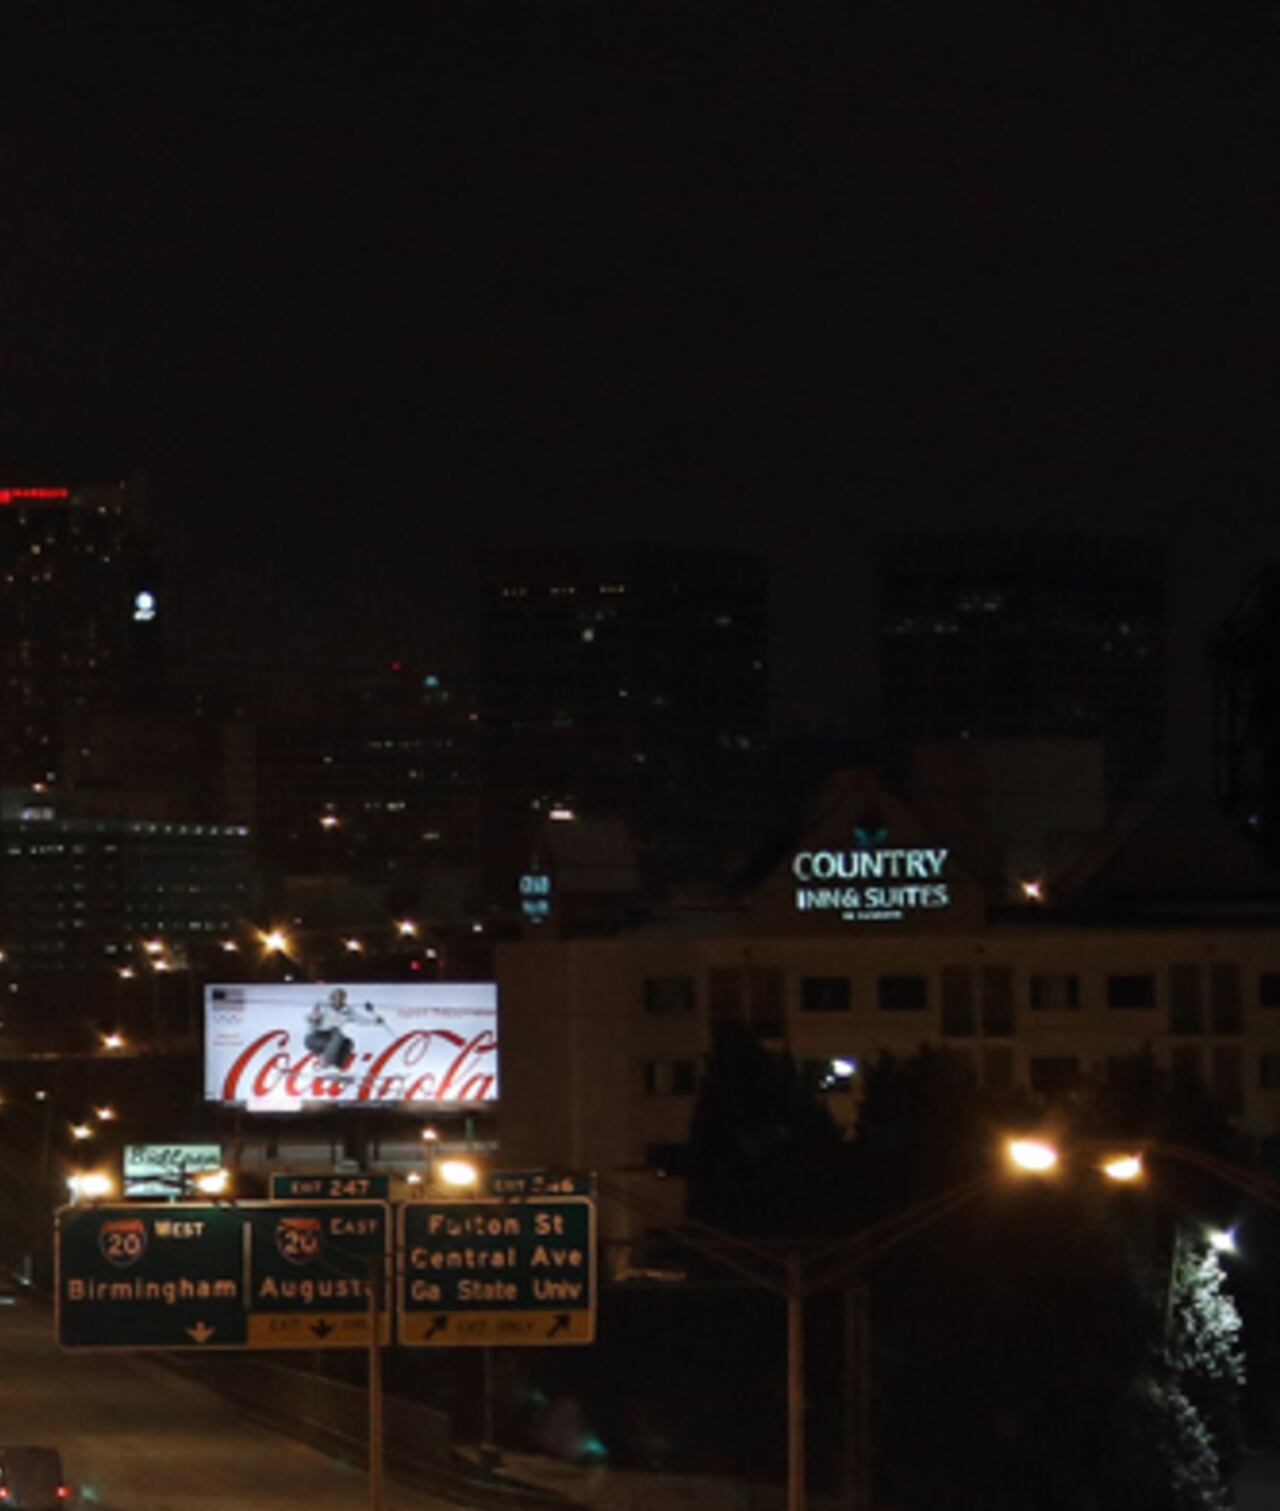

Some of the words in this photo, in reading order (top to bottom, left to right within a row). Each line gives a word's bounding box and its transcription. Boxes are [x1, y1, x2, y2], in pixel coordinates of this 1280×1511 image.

[792, 849, 949, 882] COUNTRY
[796, 888, 839, 910] INN
[842, 887, 860, 909] &
[864, 884, 950, 909] SUITES
[329, 1180, 370, 1196] 247
[155, 1221, 205, 1237] WEST
[330, 1218, 377, 1235] EAST
[534, 1213, 564, 1235] St
[108, 1234, 140, 1255] 20
[284, 1233, 318, 1254] 20
[411, 1248, 518, 1269] Central
[531, 1247, 583, 1267] Ave
[69, 1278, 236, 1304] Birmingham
[412, 1280, 441, 1300] Ga
[457, 1279, 518, 1300] State
[534, 1279, 582, 1300] Univ
